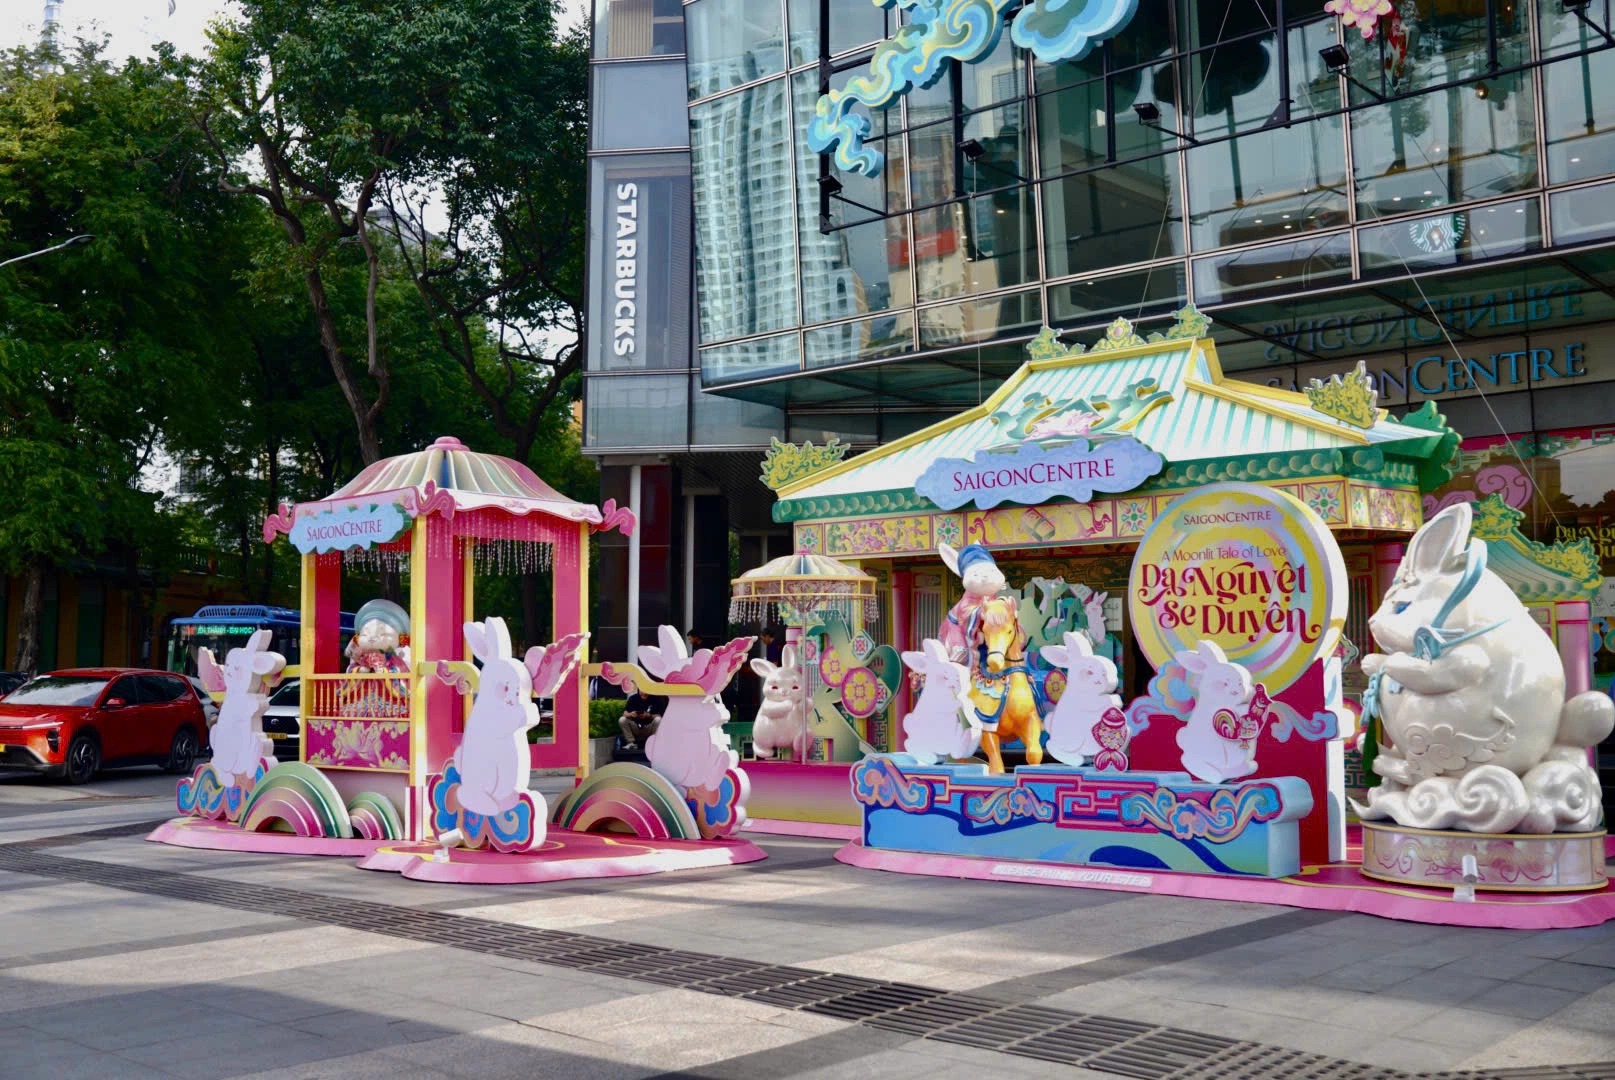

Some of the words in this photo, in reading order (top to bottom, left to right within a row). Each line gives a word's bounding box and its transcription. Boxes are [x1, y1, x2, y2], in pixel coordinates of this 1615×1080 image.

[613, 183, 638, 356] STARBUCKS
[953, 458, 1116, 492] SAIGONCENTRE
[306, 519, 383, 542] SAIGONCENTRE
[1183, 510, 1272, 526] SAIGONCENTRE
[1161, 550, 1171, 562] A
[1172, 547, 1214, 562] Moonlit
[1216, 545, 1239, 560] Tale
[1241, 544, 1255, 559] of
[1256, 544, 1288, 559] Love
[1158, 600, 1197, 630] Se
[1200, 600, 1323, 644] Duyên
